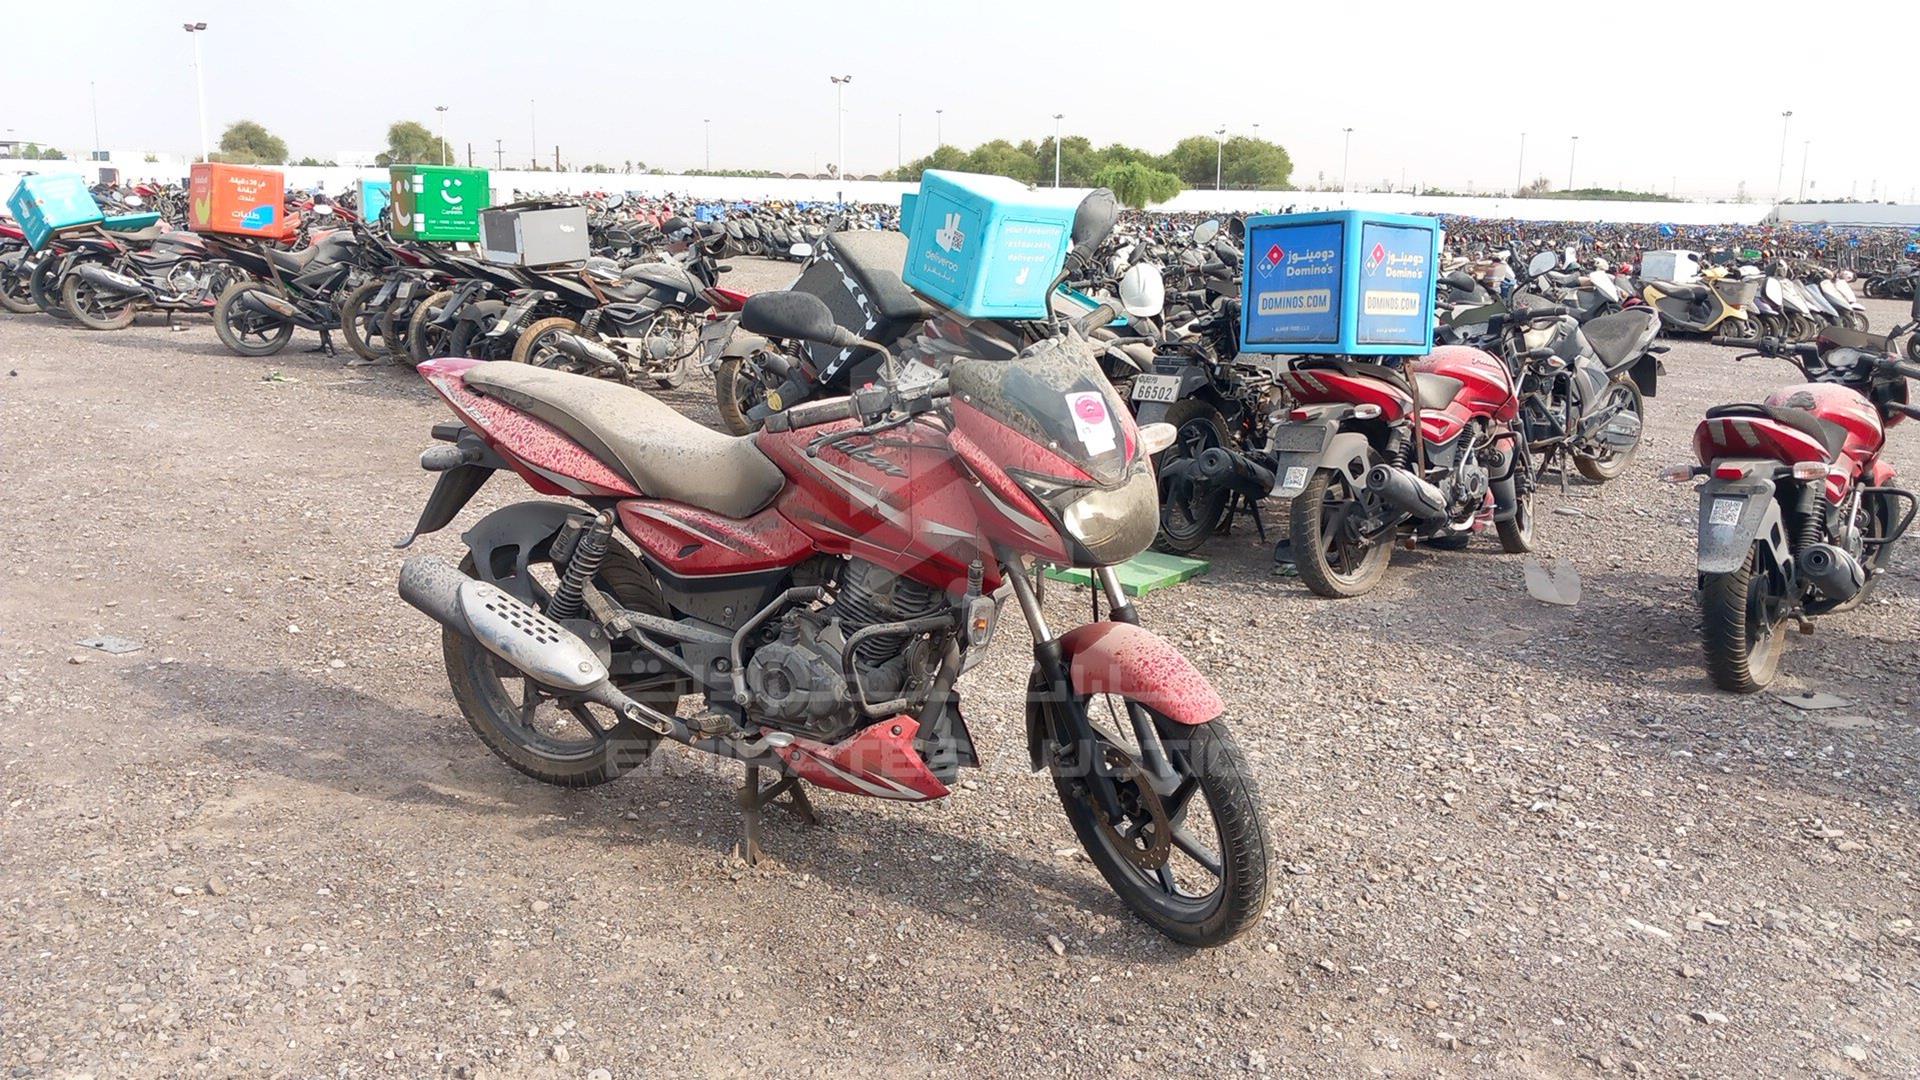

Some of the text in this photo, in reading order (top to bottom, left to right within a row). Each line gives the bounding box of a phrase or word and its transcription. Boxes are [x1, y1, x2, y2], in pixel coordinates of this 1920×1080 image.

[925, 249, 959, 272] deliveroo
[1286, 266, 1334, 277] Domino's
[1385, 266, 1423, 279] Domino's
[1262, 295, 1328, 311] DOMINOS.COM
[1367, 296, 1418, 311] DOMINOS.COM
[1138, 385, 1172, 401] 66502
